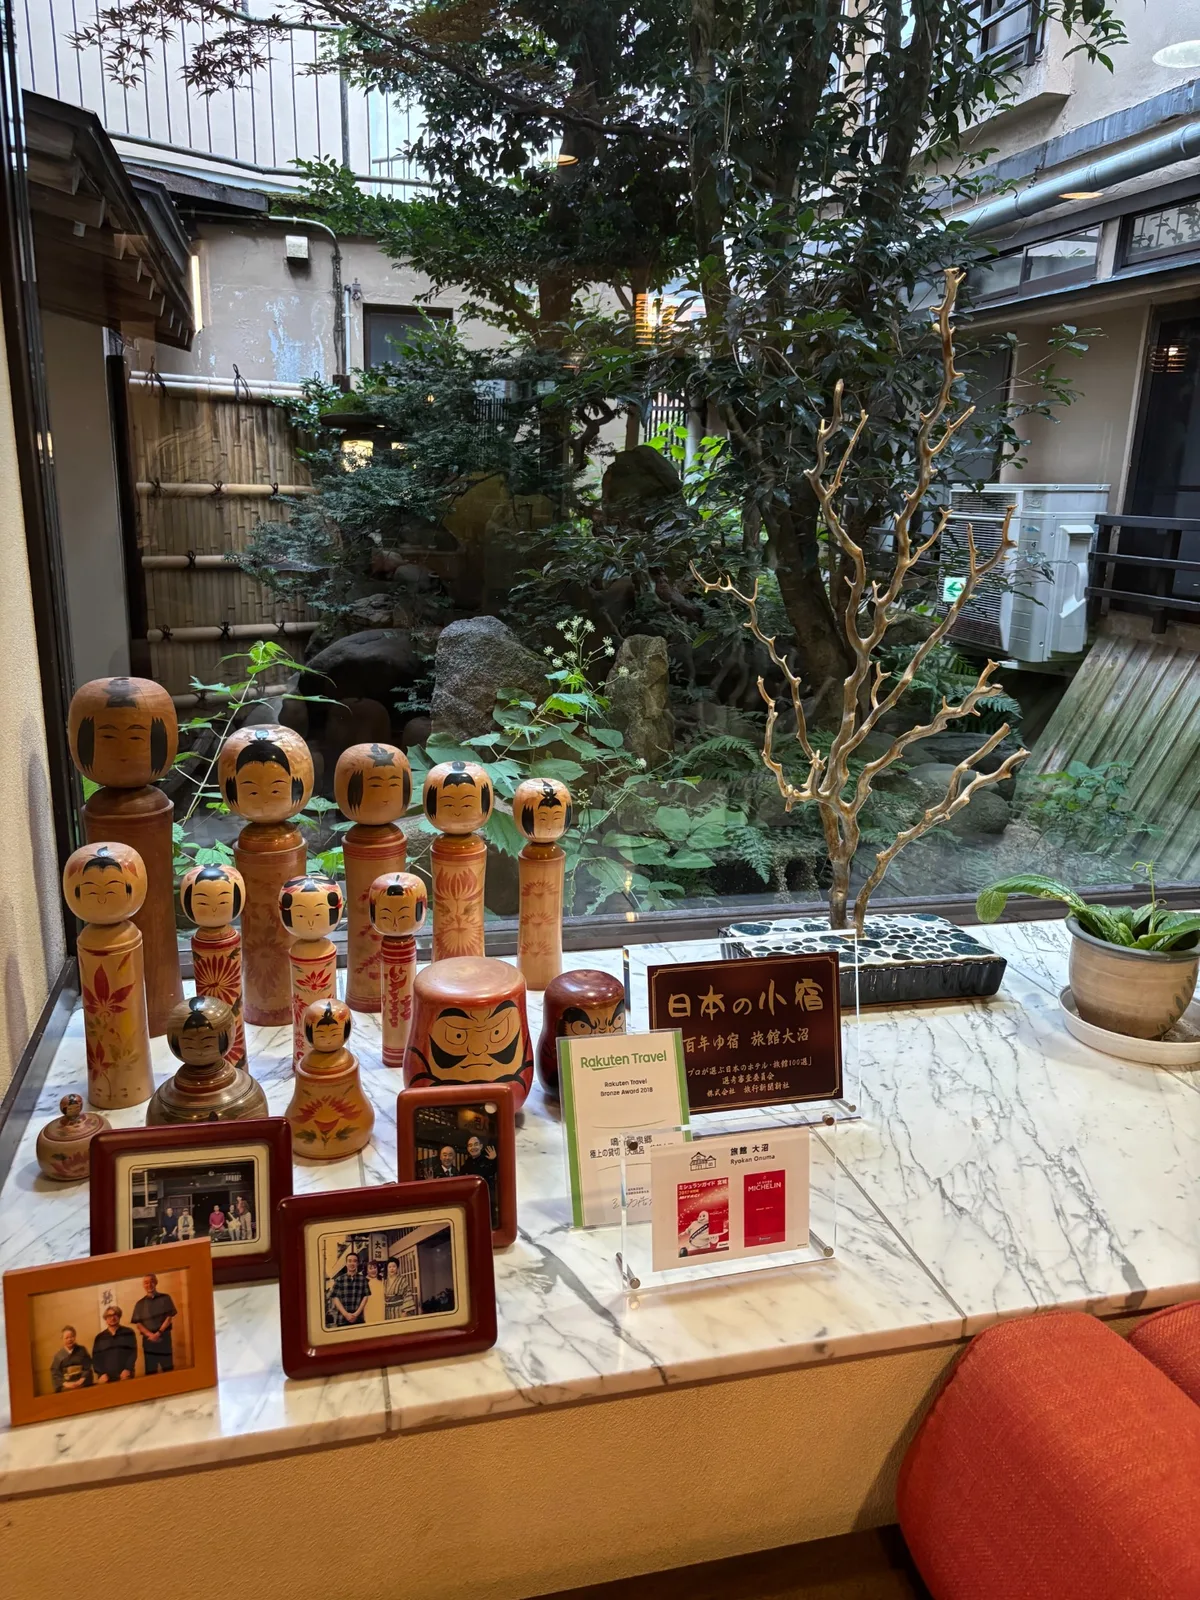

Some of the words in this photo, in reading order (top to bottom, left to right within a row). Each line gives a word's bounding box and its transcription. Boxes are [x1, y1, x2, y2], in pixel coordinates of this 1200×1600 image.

[668, 978, 824, 1021] 日本の小宿
[683, 1032, 739, 1053] 百年ゆ宿
[751, 1027, 809, 1047] 旅館大沼
[580, 1054, 630, 1069] Rakuten
[631, 1050, 667, 1064] Travel
[604, 1080, 630, 1088] Rakuten
[630, 1078, 648, 1086] Travel
[752, 1143, 769, 1153] 大沼
[730, 1157, 753, 1166] Ryokan
[753, 1154, 775, 1162] Onuma
[748, 1181, 782, 1192] MICHELIN
